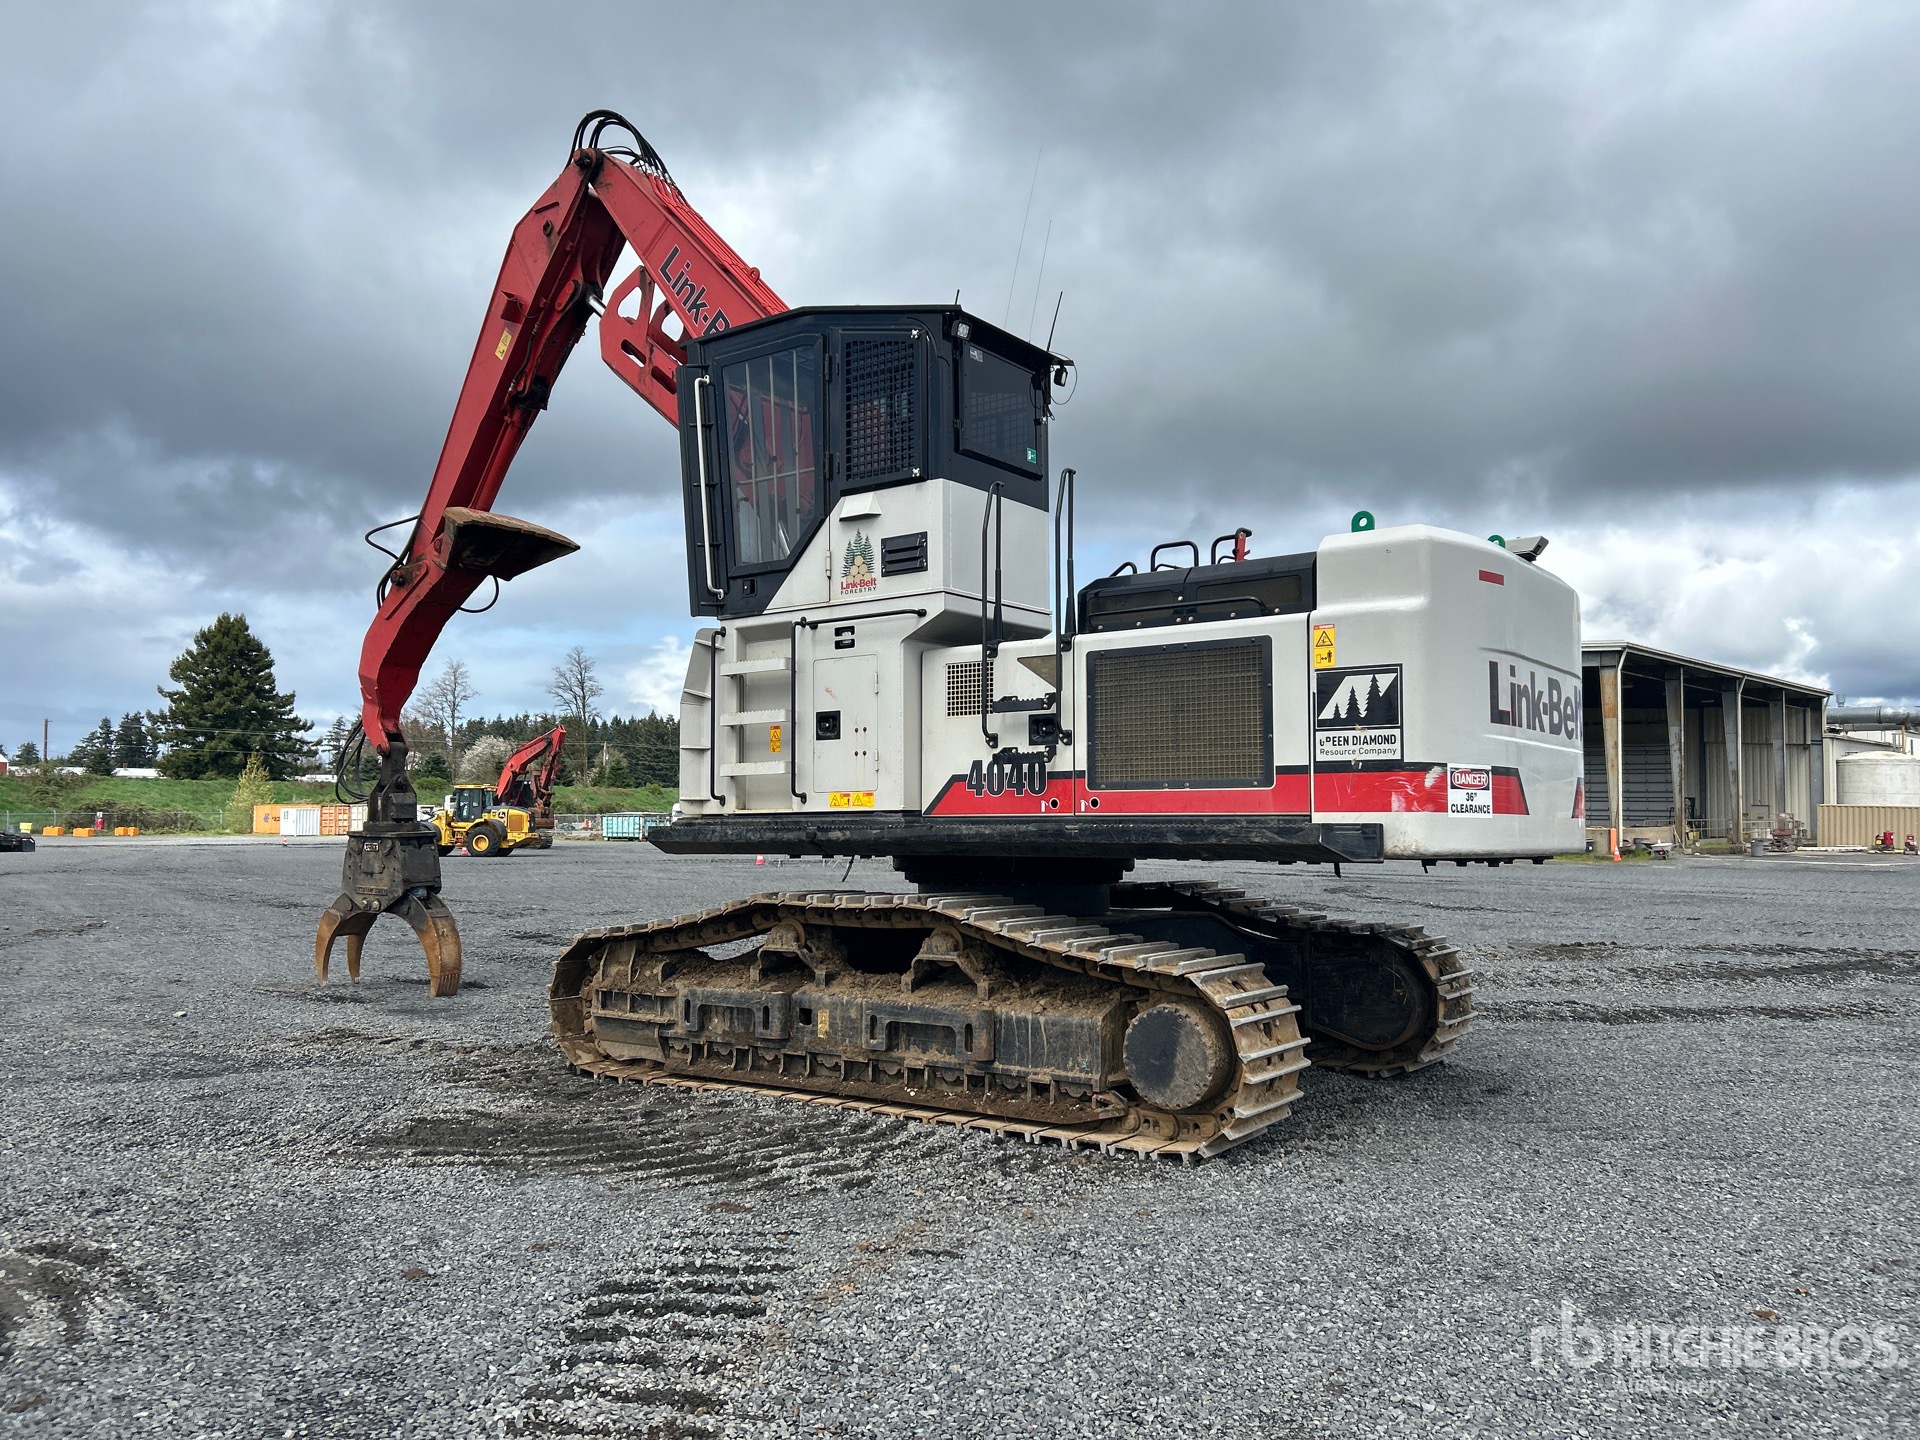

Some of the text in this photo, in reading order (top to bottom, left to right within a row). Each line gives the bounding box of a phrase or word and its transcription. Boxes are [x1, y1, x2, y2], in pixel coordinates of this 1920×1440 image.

[658, 244, 732, 337] Link-B
[840, 577, 877, 590] Link-Belt
[840, 586, 877, 595] FORESTRY
[1352, 734, 1397, 746] DIAMOND
[1319, 746, 1398, 756] Resource Company
[966, 759, 1048, 797] 4040
[1454, 772, 1487, 785] DANGER
[1450, 803, 1491, 814] CLEARANCE
